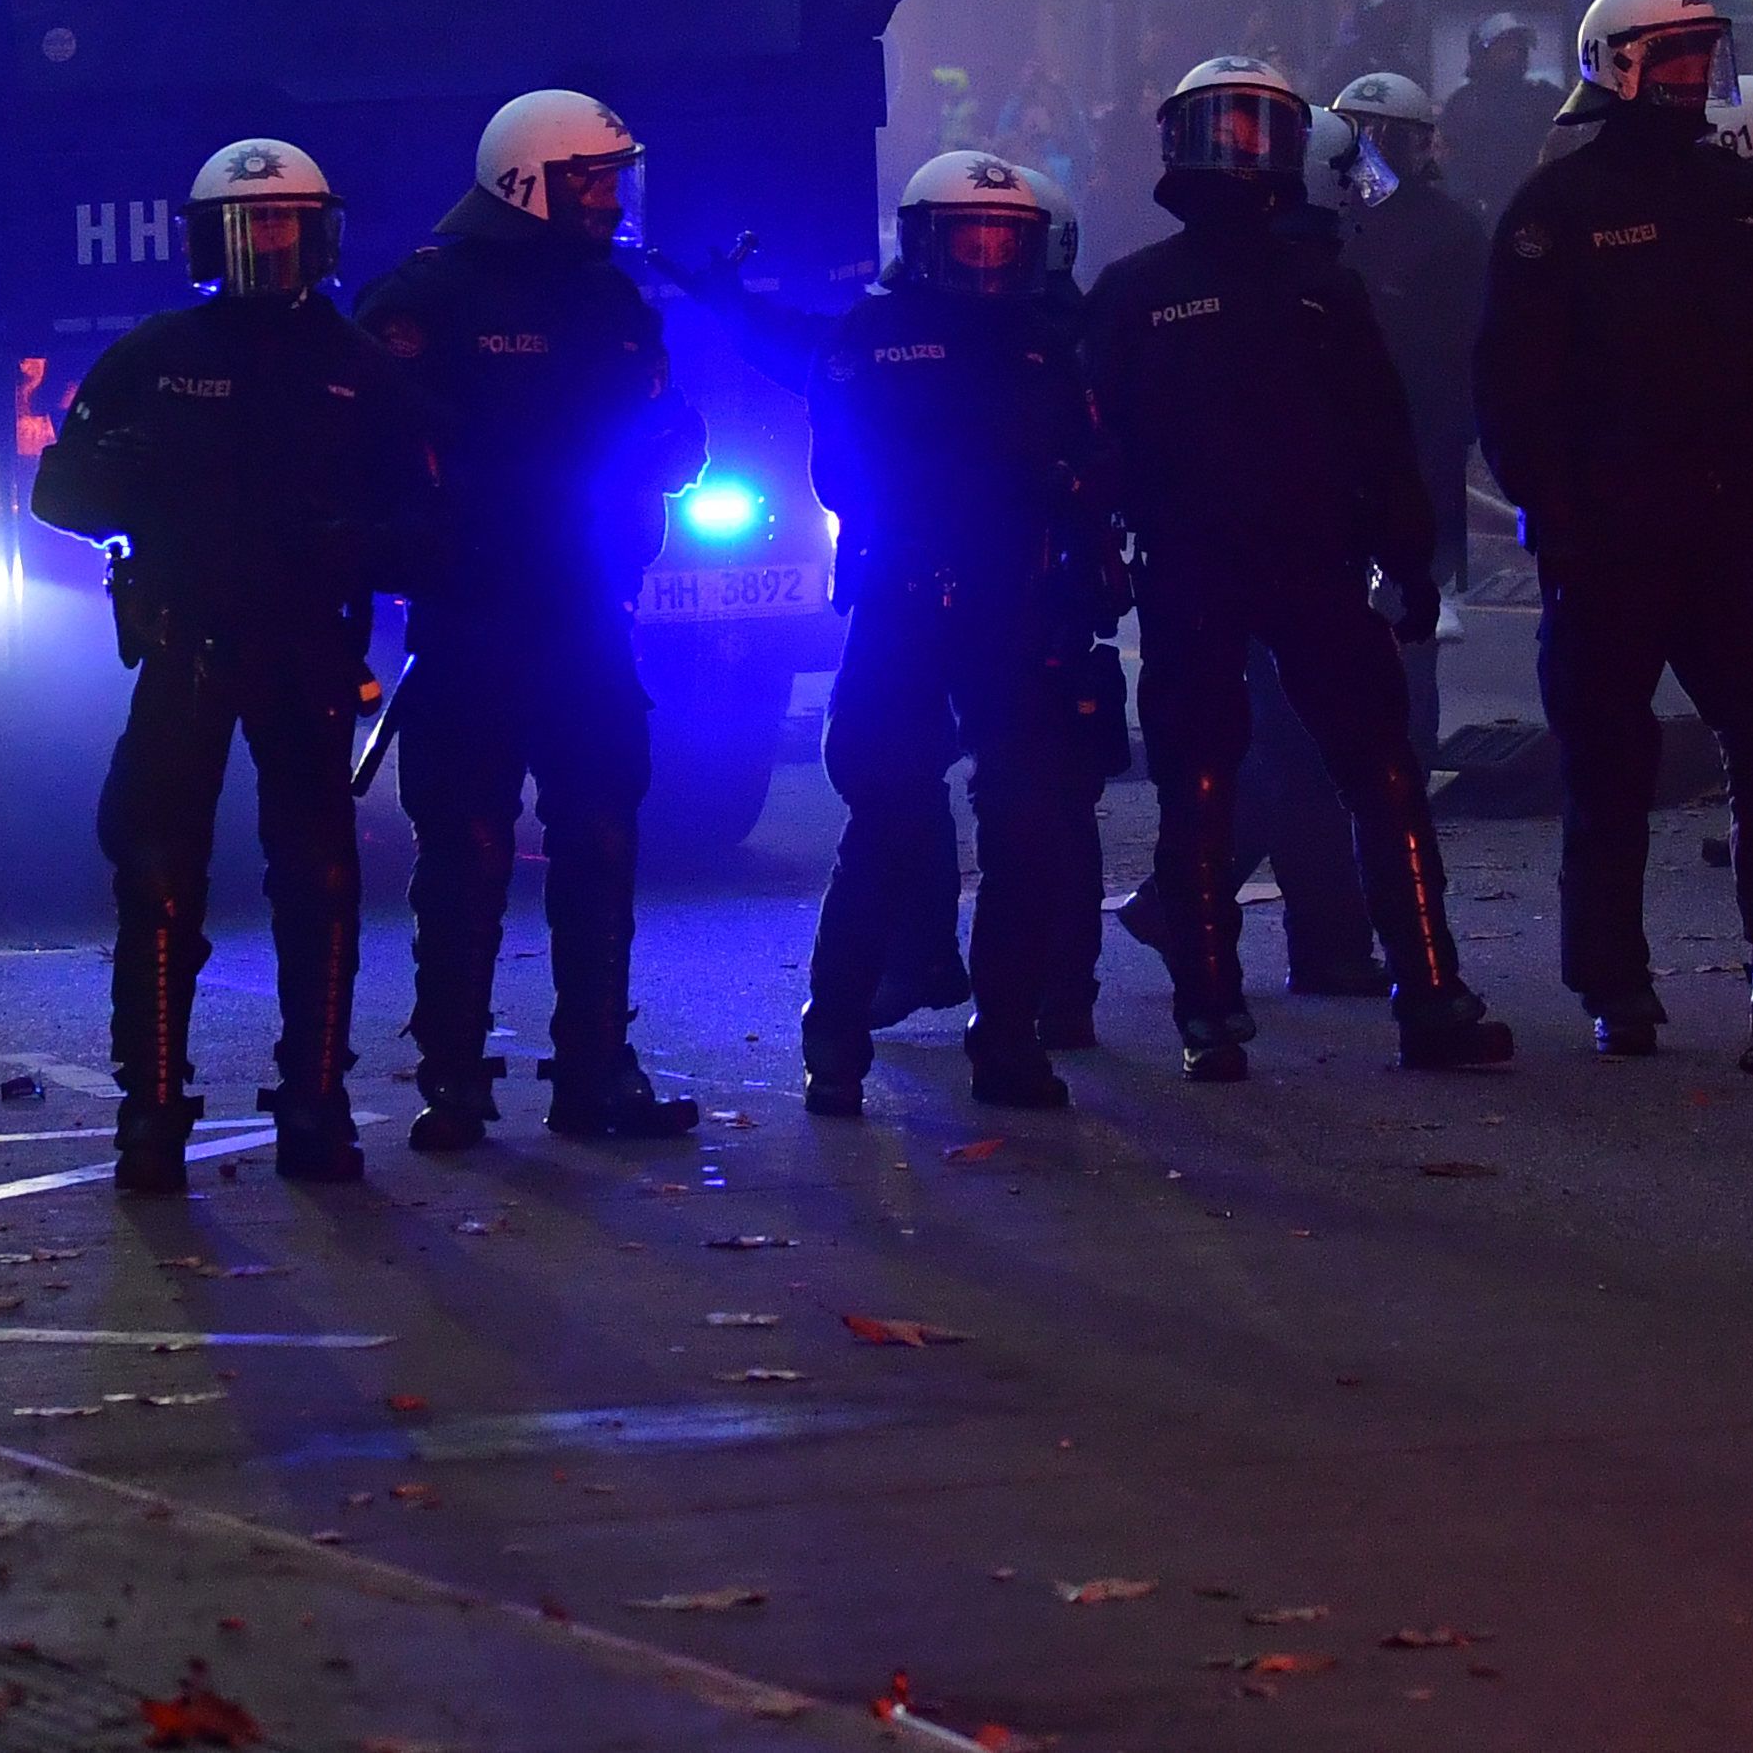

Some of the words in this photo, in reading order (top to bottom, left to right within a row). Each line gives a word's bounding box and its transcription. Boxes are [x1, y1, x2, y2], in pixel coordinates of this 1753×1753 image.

[1582, 39, 1600, 72] 41
[496, 167, 537, 207] 41
[76, 200, 170, 265] HH
[1593, 223, 1658, 247] POLIZEI
[1151, 297, 1221, 327] POLIZEI
[478, 334, 549, 353] POLIZEI
[873, 344, 946, 363] POLIZEI
[158, 376, 232, 397] POLIZEI
[654, 576, 699, 609] HH
[721, 569, 804, 604] 3892
